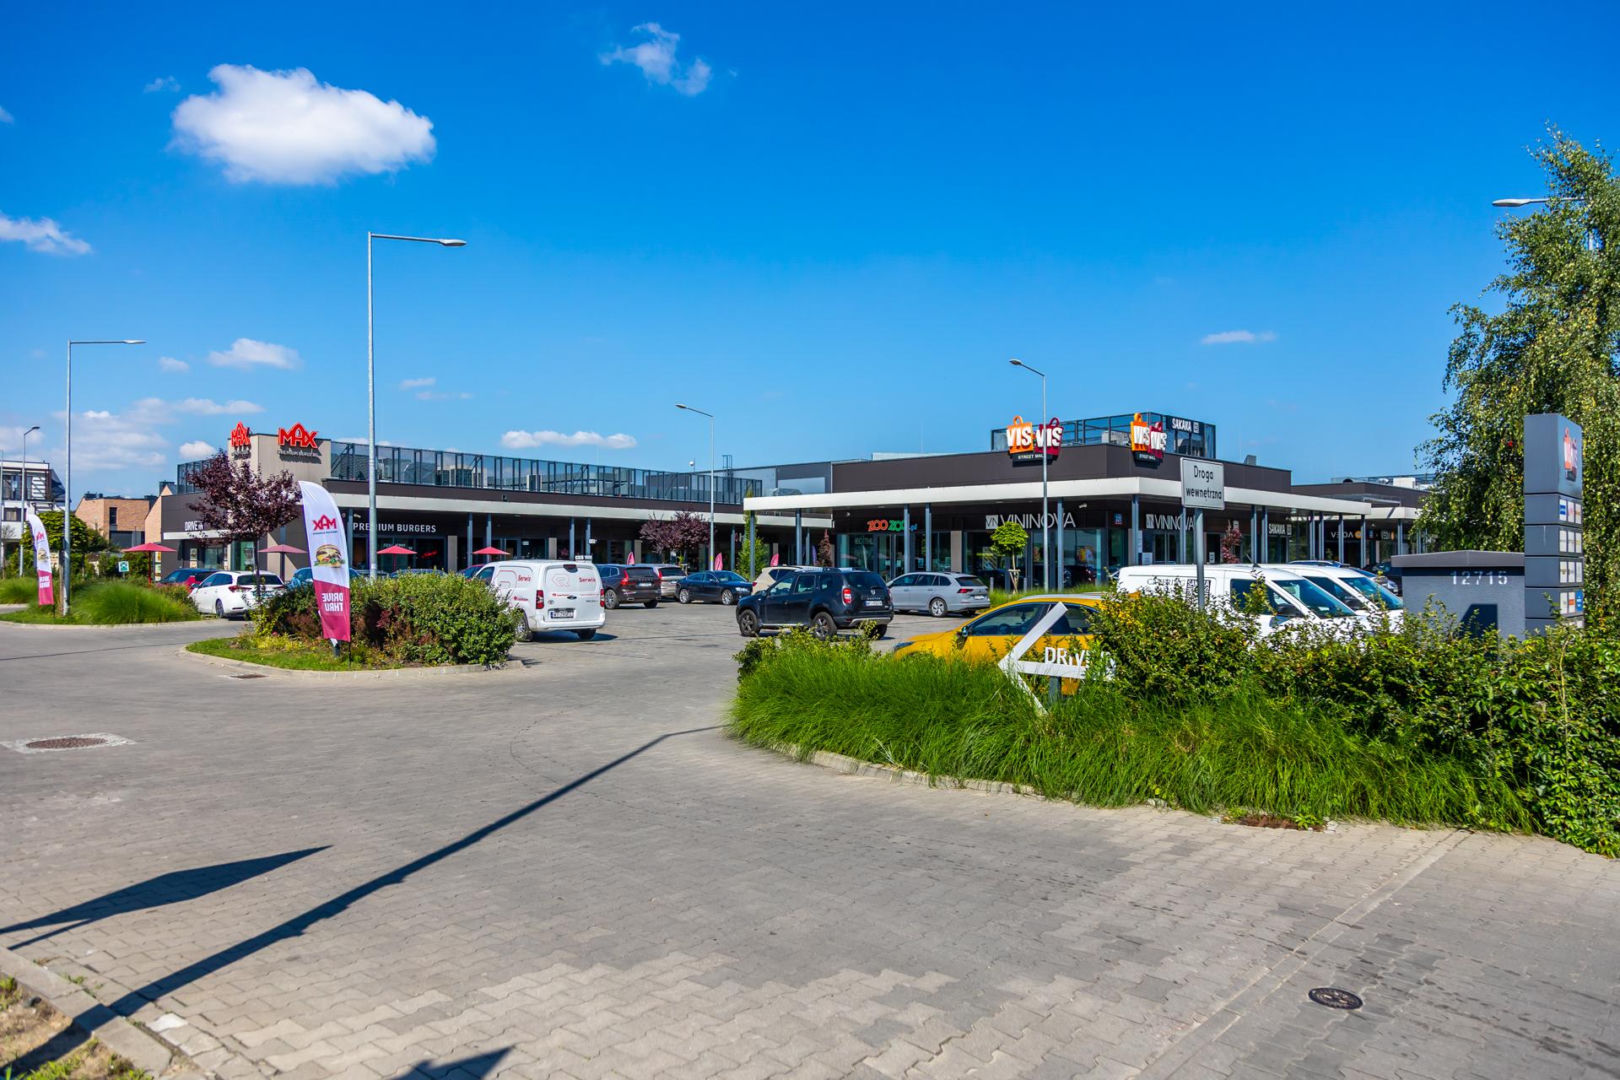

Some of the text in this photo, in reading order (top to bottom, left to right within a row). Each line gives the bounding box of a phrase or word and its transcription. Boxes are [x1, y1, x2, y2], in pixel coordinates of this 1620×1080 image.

[231, 421, 251, 447] MAX
[278, 421, 318, 448] MAX
[1006, 427, 1063, 447] VIS VIS
[1133, 425, 1167, 451] VIS VIS
[1193, 465, 1214, 483] Droga
[353, 522, 436, 532] PREIUM BURGERS
[867, 520, 888, 531] ZOO
[1450, 570, 1508, 585] 12715
[1044, 646, 1090, 668] DRIV
